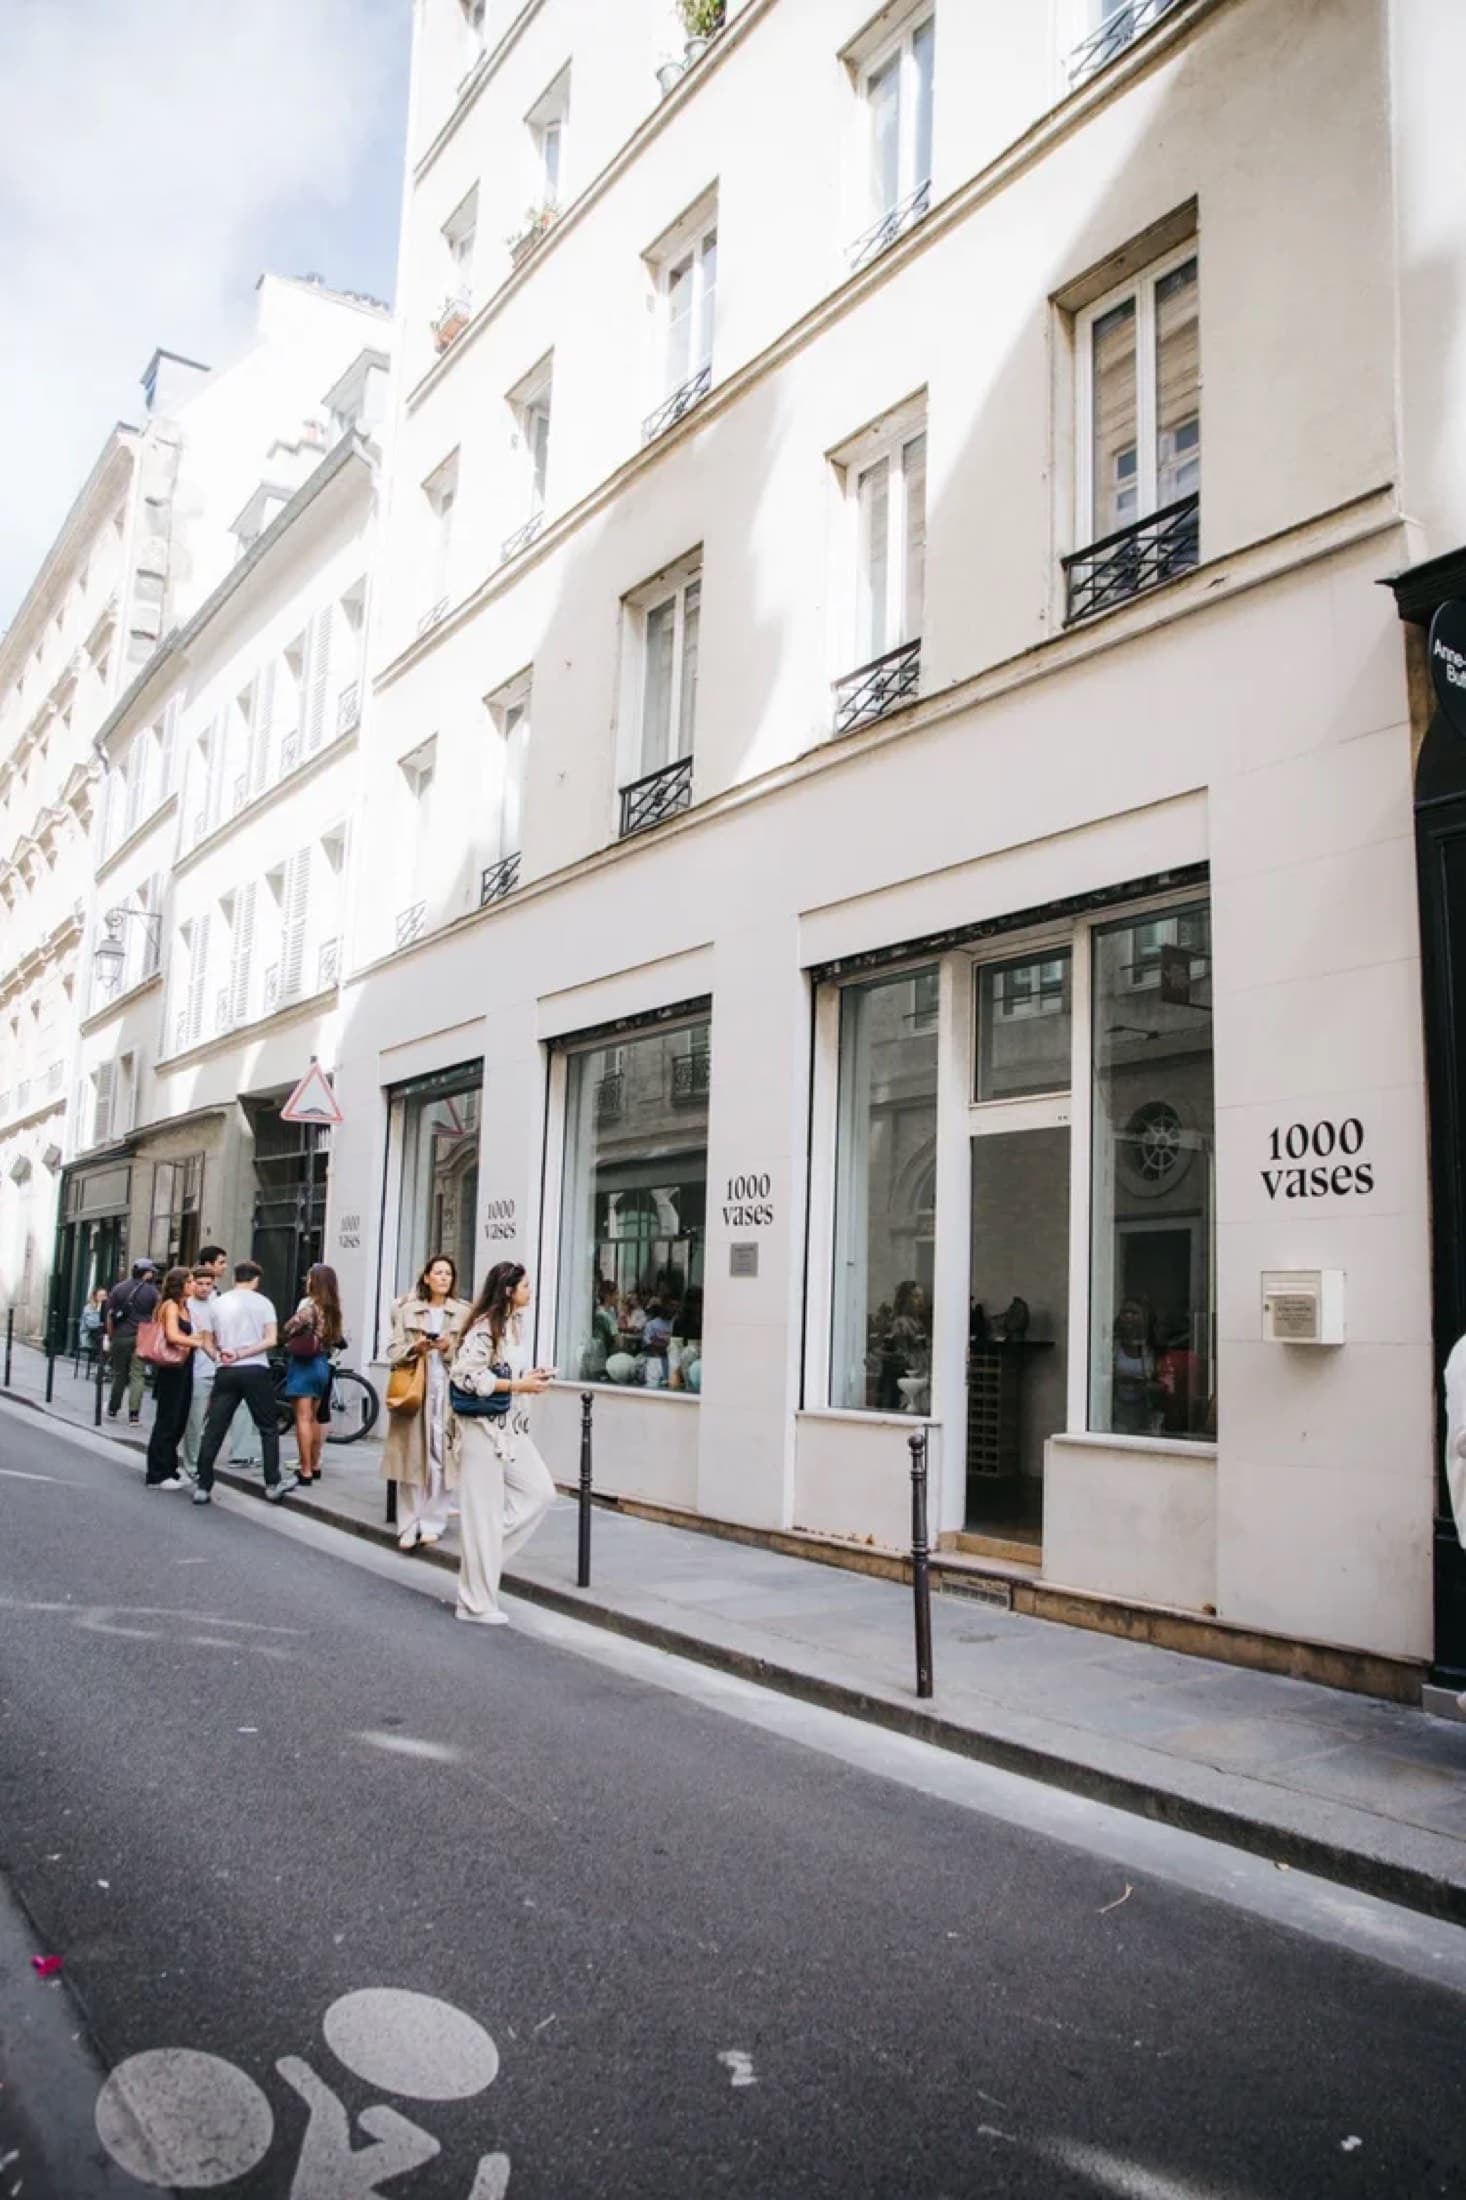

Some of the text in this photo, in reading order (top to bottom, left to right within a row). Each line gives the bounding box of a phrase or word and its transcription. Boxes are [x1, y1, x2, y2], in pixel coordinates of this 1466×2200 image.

[1269, 1118, 1364, 1160] 1000
[727, 1173, 771, 1201] 1000
[1260, 1163, 1374, 1200] vases
[722, 1204, 773, 1226] vases
